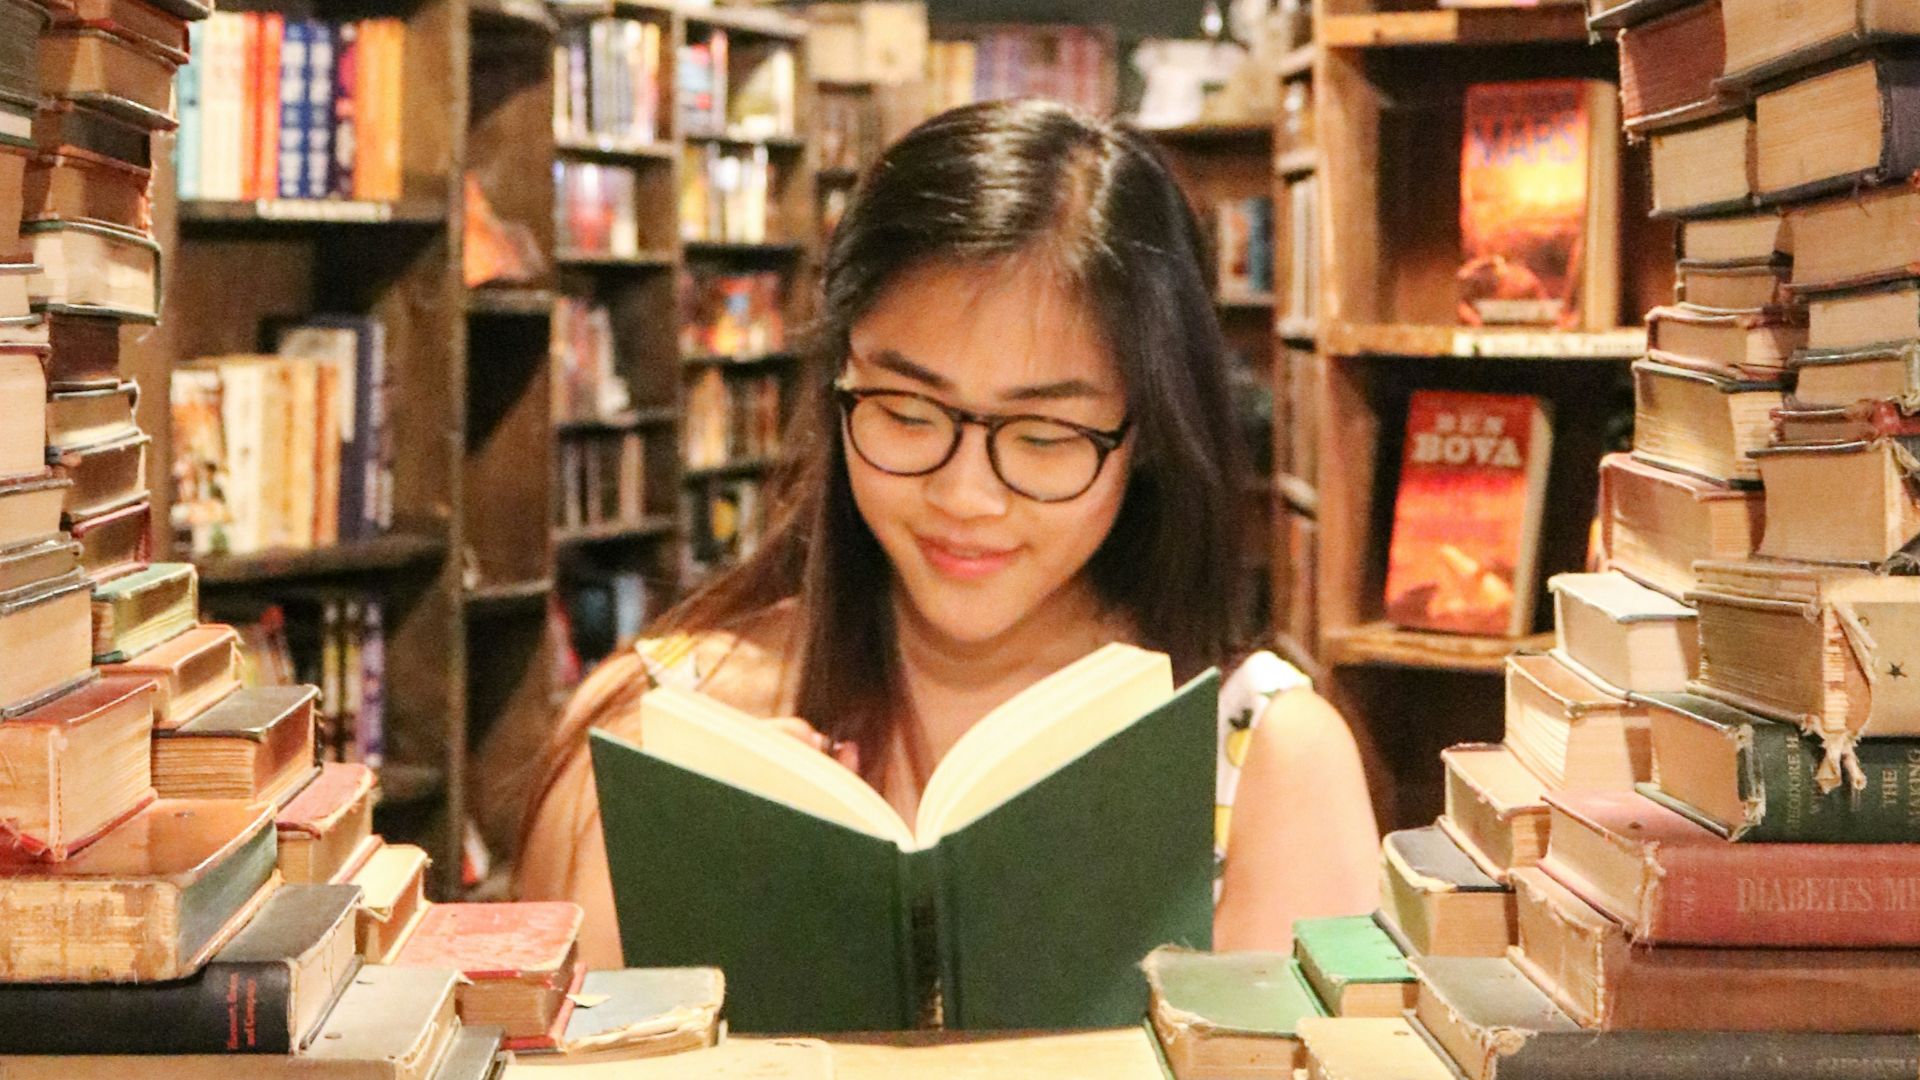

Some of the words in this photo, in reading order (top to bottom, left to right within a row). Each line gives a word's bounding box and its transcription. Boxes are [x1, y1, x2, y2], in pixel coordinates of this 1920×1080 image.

[1471, 111, 1579, 169] MARS
[1435, 413, 1507, 436] BEN
[1411, 433, 1522, 467] BOVA
[1881, 768, 1898, 807] THE
[1737, 876, 1873, 913] DIABETES
